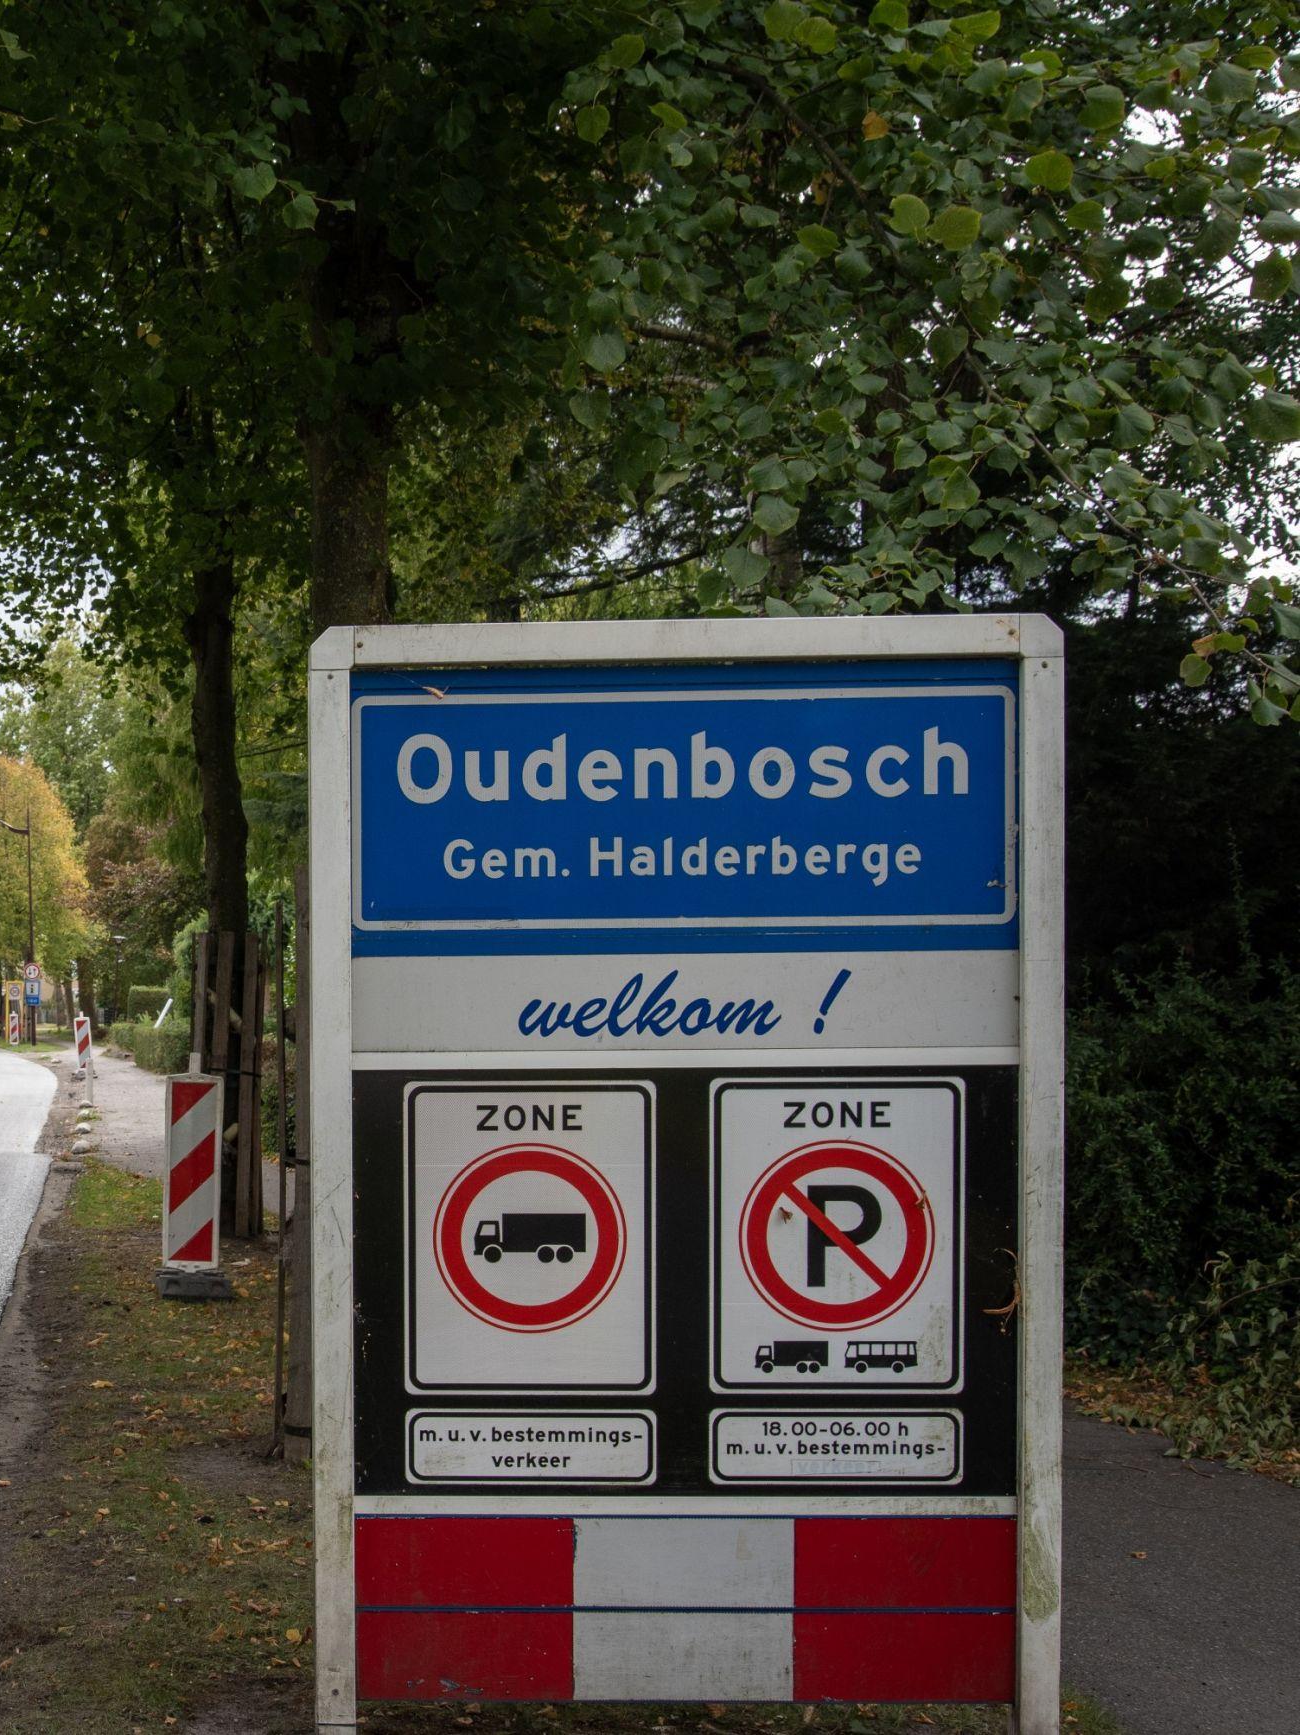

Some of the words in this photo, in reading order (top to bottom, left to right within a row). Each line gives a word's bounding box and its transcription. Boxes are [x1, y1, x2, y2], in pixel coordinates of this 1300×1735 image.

[396, 726, 970, 805] Oudenbosch
[443, 838, 570, 880] Gem.
[589, 836, 922, 887] Halderberge
[518, 969, 782, 1038] welkom
[476, 1104, 583, 1132] ZONE
[783, 1101, 891, 1129] ZONE
[762, 1421, 891, 1437] 18.00-06.00
[898, 1421, 909, 1437] h
[491, 1452, 571, 1468] verkeer
